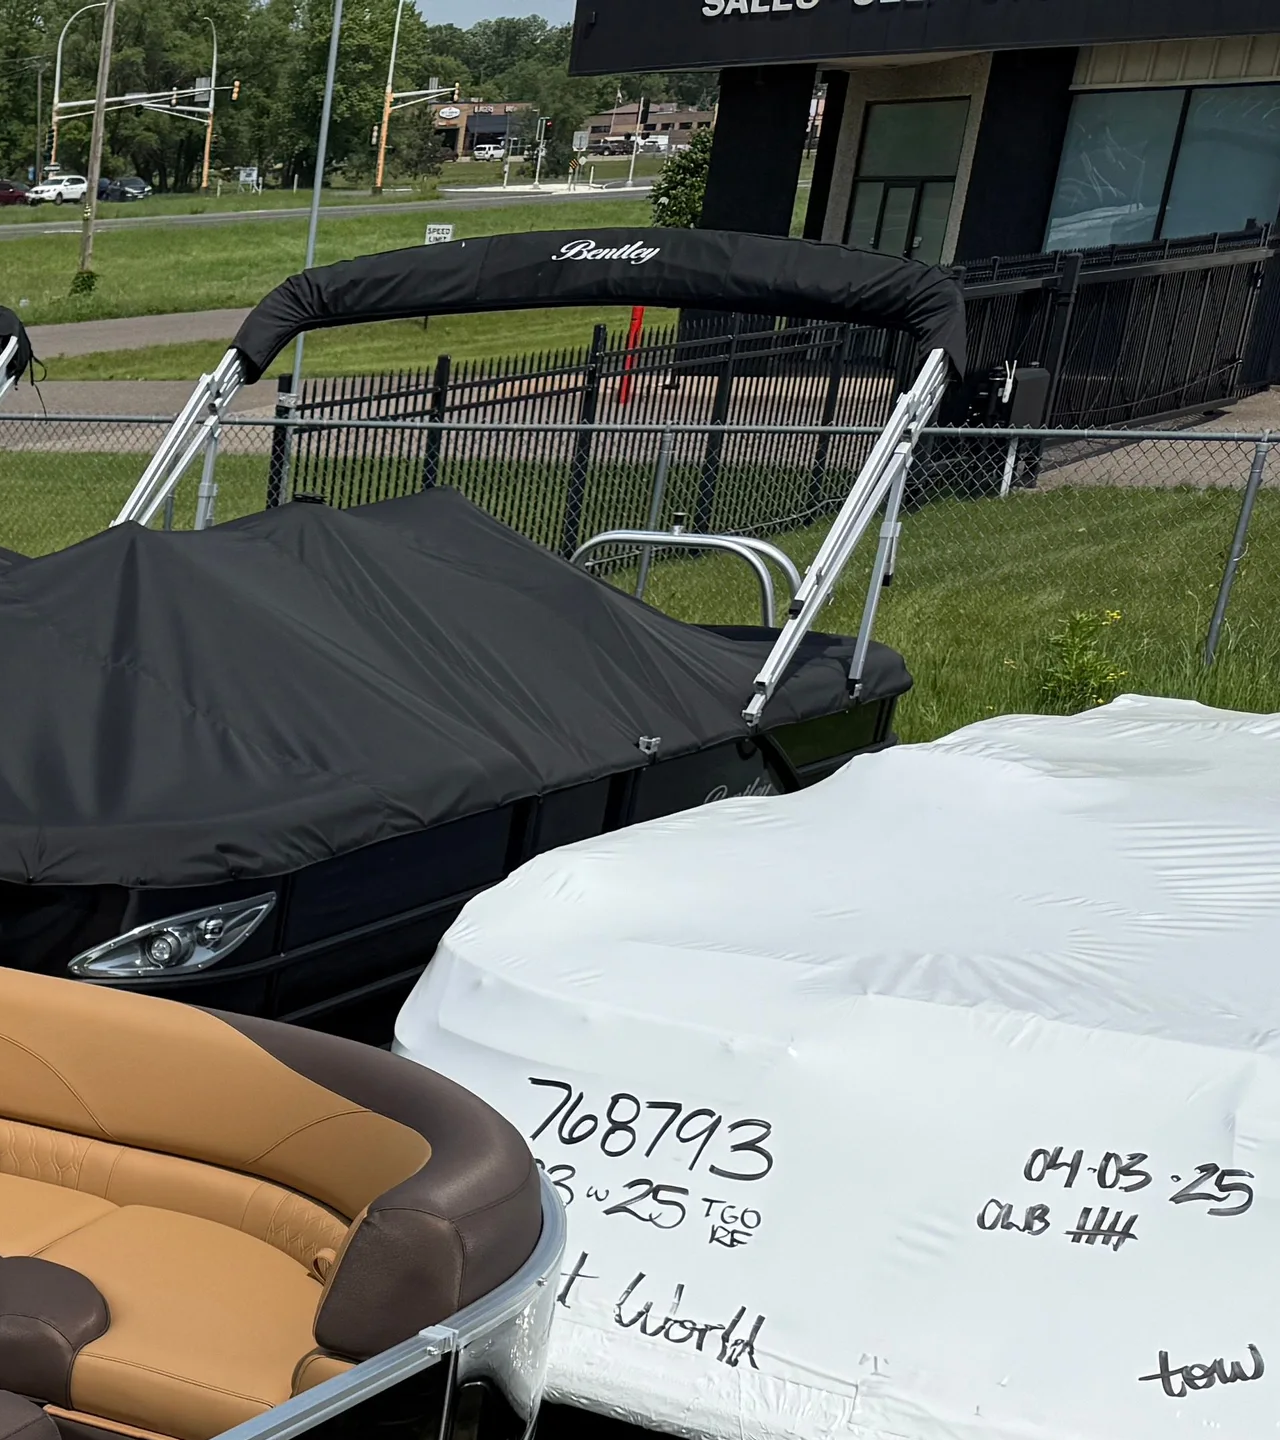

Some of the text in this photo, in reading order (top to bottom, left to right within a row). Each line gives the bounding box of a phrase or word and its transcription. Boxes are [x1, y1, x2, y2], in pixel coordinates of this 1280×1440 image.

[551, 239, 661, 265] Bentley
[528, 1077, 774, 1181] 768793
[535, 1158, 576, 1206] 3
[602, 1178, 689, 1229] 25
[613, 1271, 766, 1370] World
[1138, 1343, 1265, 1398] tow
